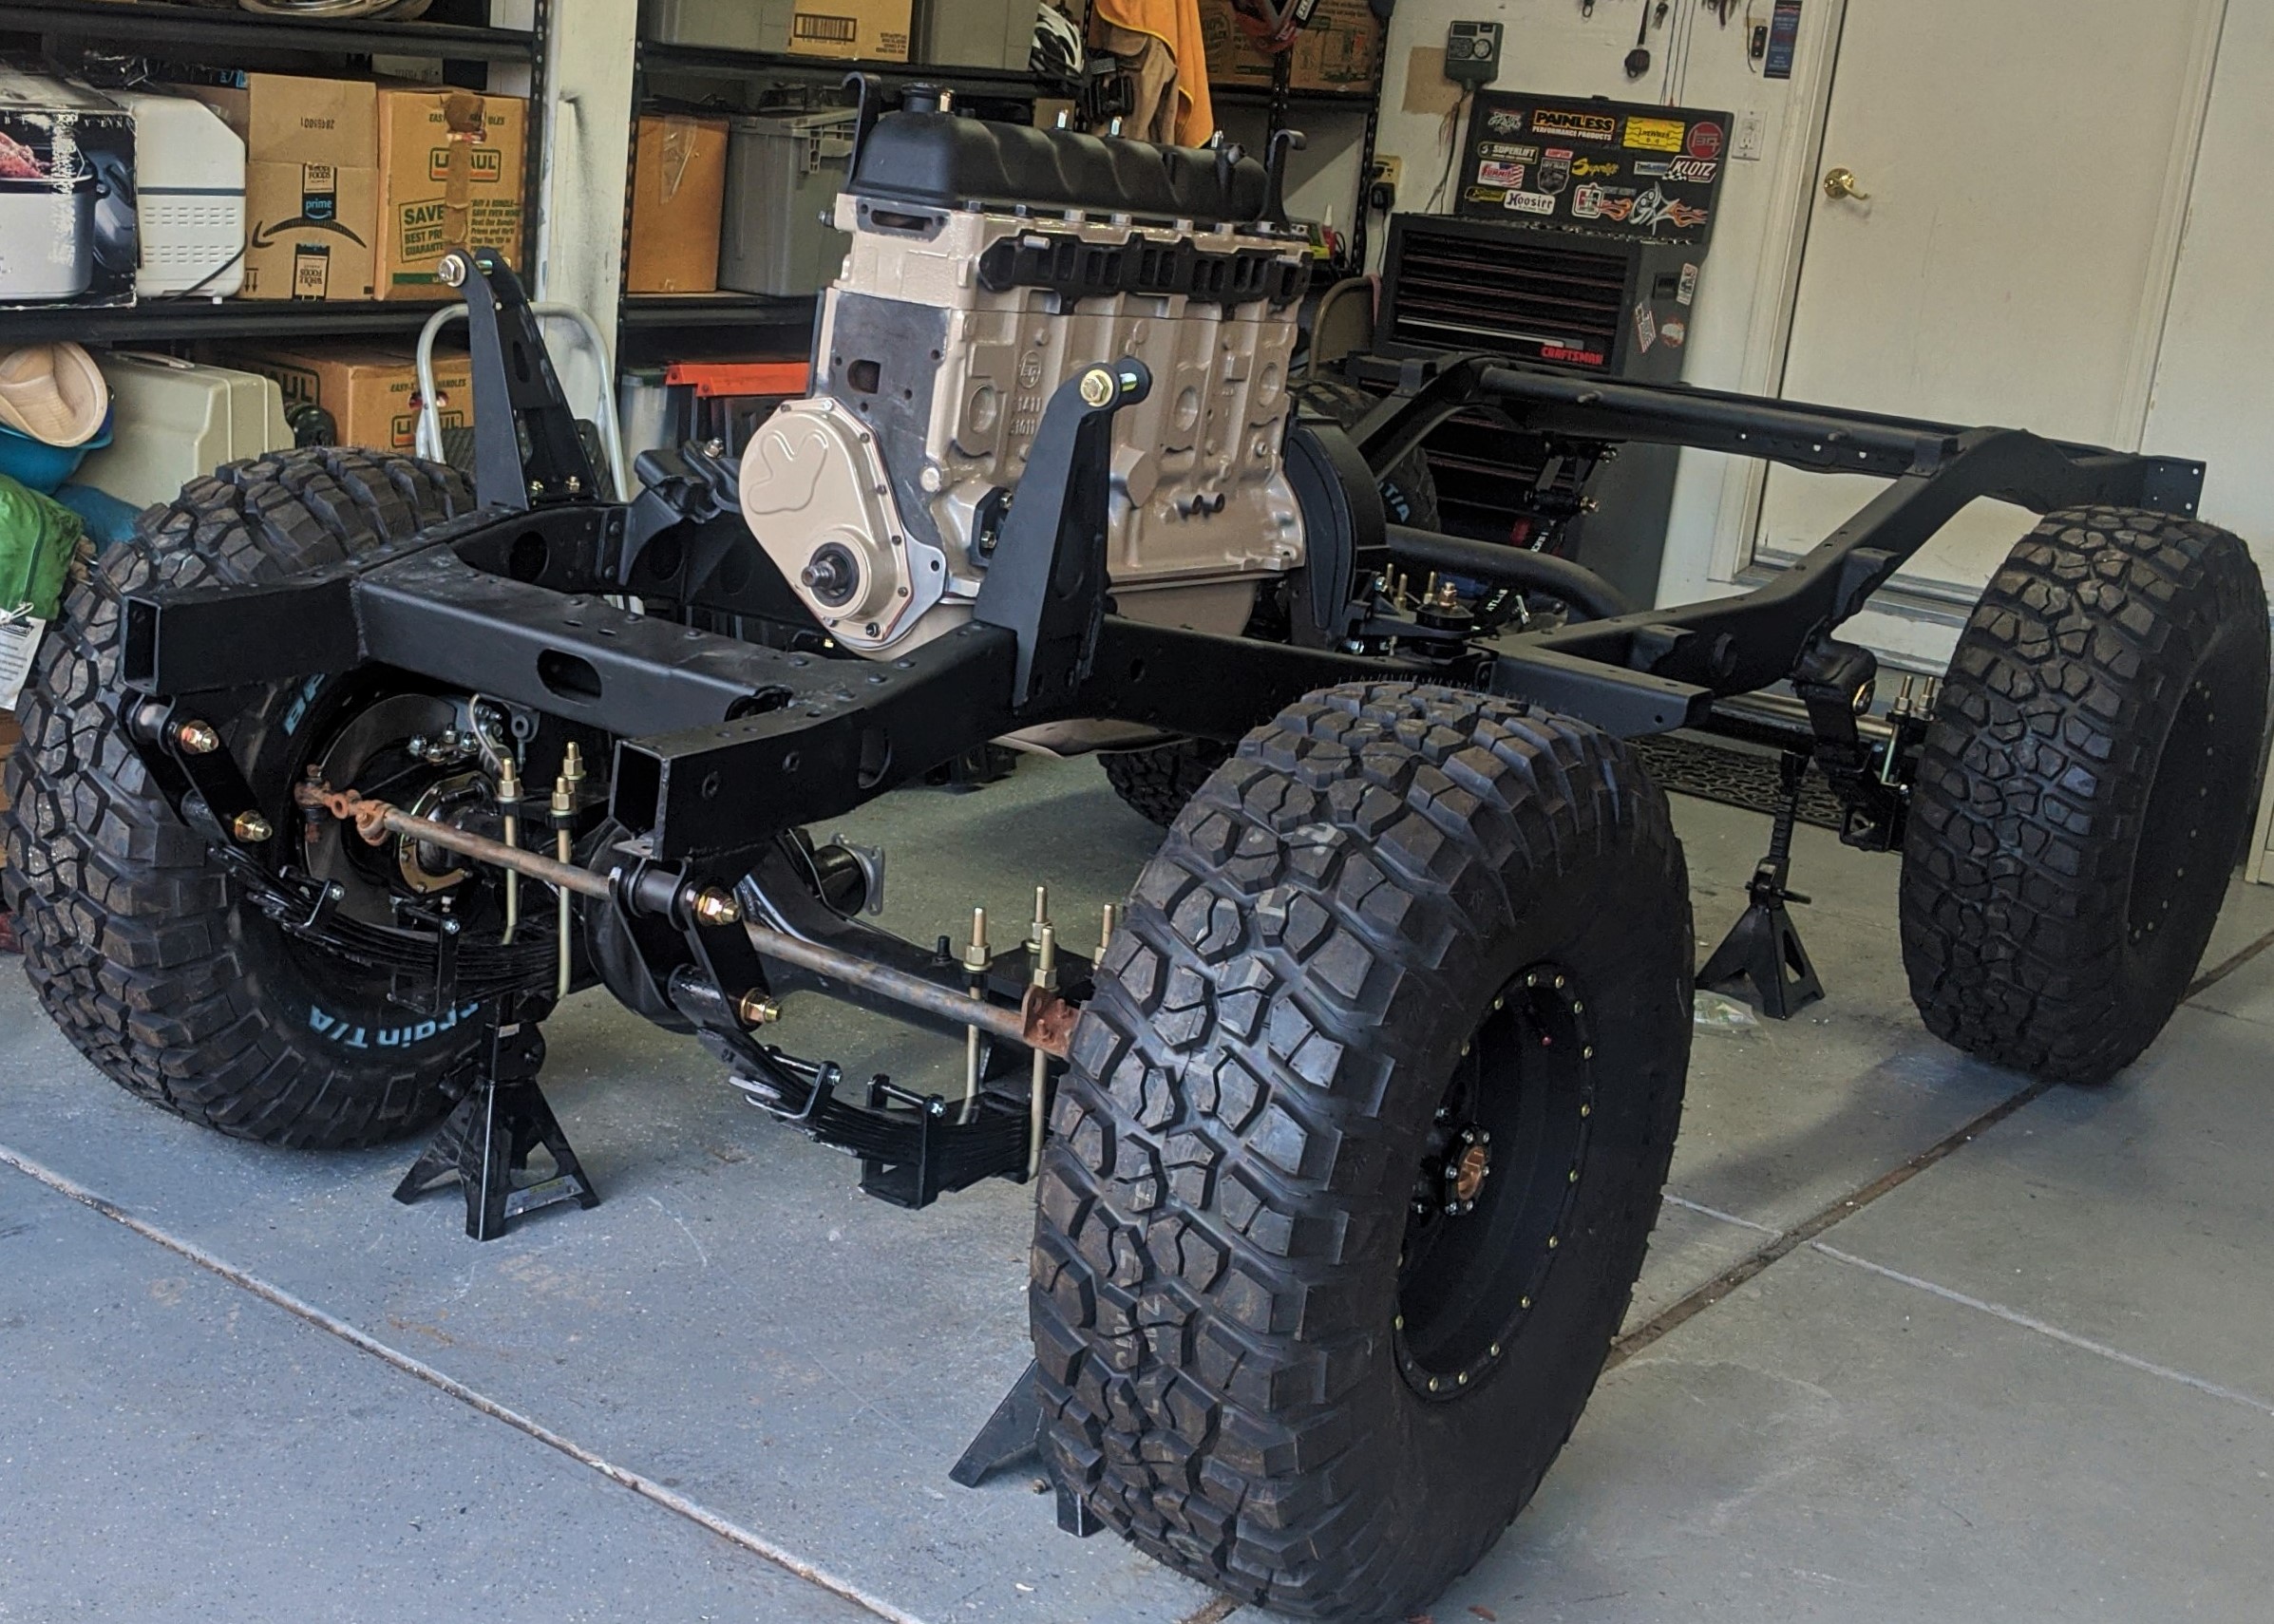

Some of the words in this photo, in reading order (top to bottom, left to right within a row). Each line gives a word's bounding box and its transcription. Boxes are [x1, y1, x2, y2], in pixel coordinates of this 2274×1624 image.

[1536, 110, 1614, 132] PAINLESS
[1532, 125, 1577, 138] PERFORMANCE
[1577, 131, 1612, 141] PRODUCTS
[1492, 145, 1536, 158] SUPERLIFT
[1672, 161, 1716, 176] KLOTZ
[306, 198, 332, 211] prime
[1507, 193, 1553, 209] Hoosier
[404, 204, 445, 225] SAVE
[405, 231, 426, 244] BEST
[428, 229, 443, 241] PRI
[1541, 346, 1603, 366] CRAFTSMAN
[308, 1004, 369, 1049] T/A
